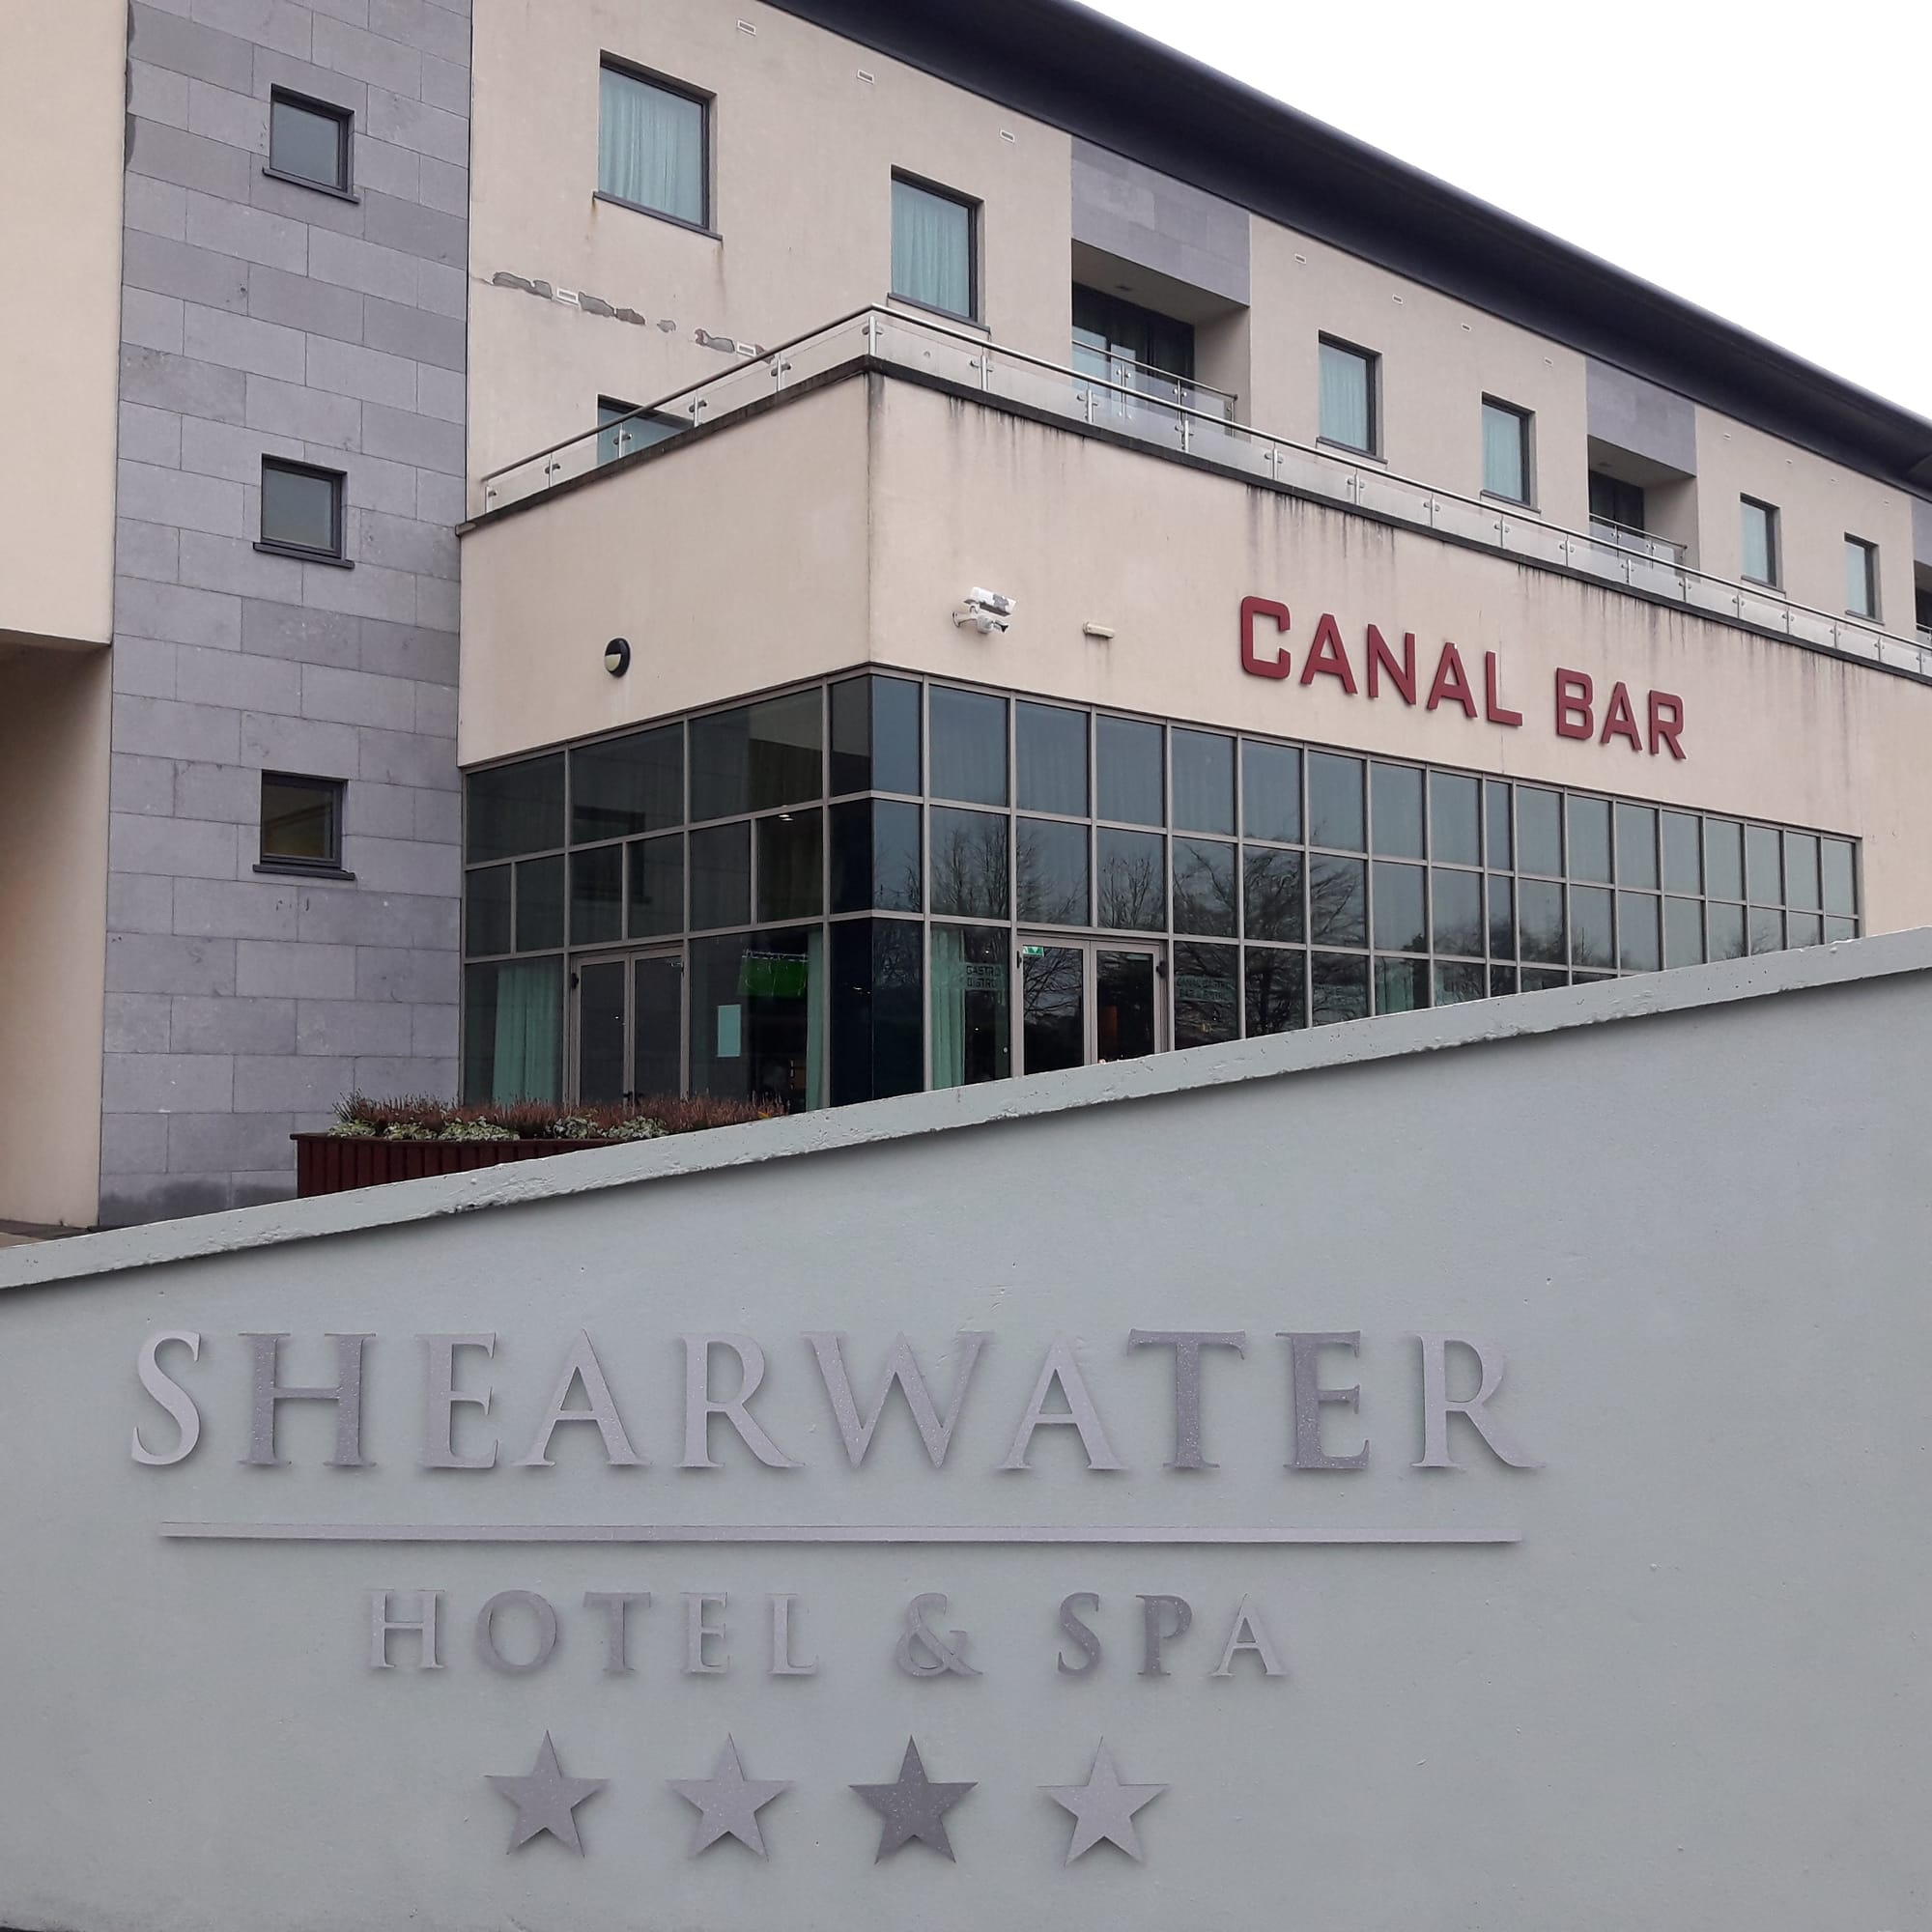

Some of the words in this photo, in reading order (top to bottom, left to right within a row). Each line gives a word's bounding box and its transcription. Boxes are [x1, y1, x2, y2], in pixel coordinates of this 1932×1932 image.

[1241, 595, 1523, 726] CANAL
[1556, 667, 1687, 760] BAR
[131, 1328, 1547, 1469] SHEARWATER
[371, 1589, 818, 1675] HOTEL
[895, 1592, 983, 1676] &
[1058, 1593, 1288, 1677] SPA
